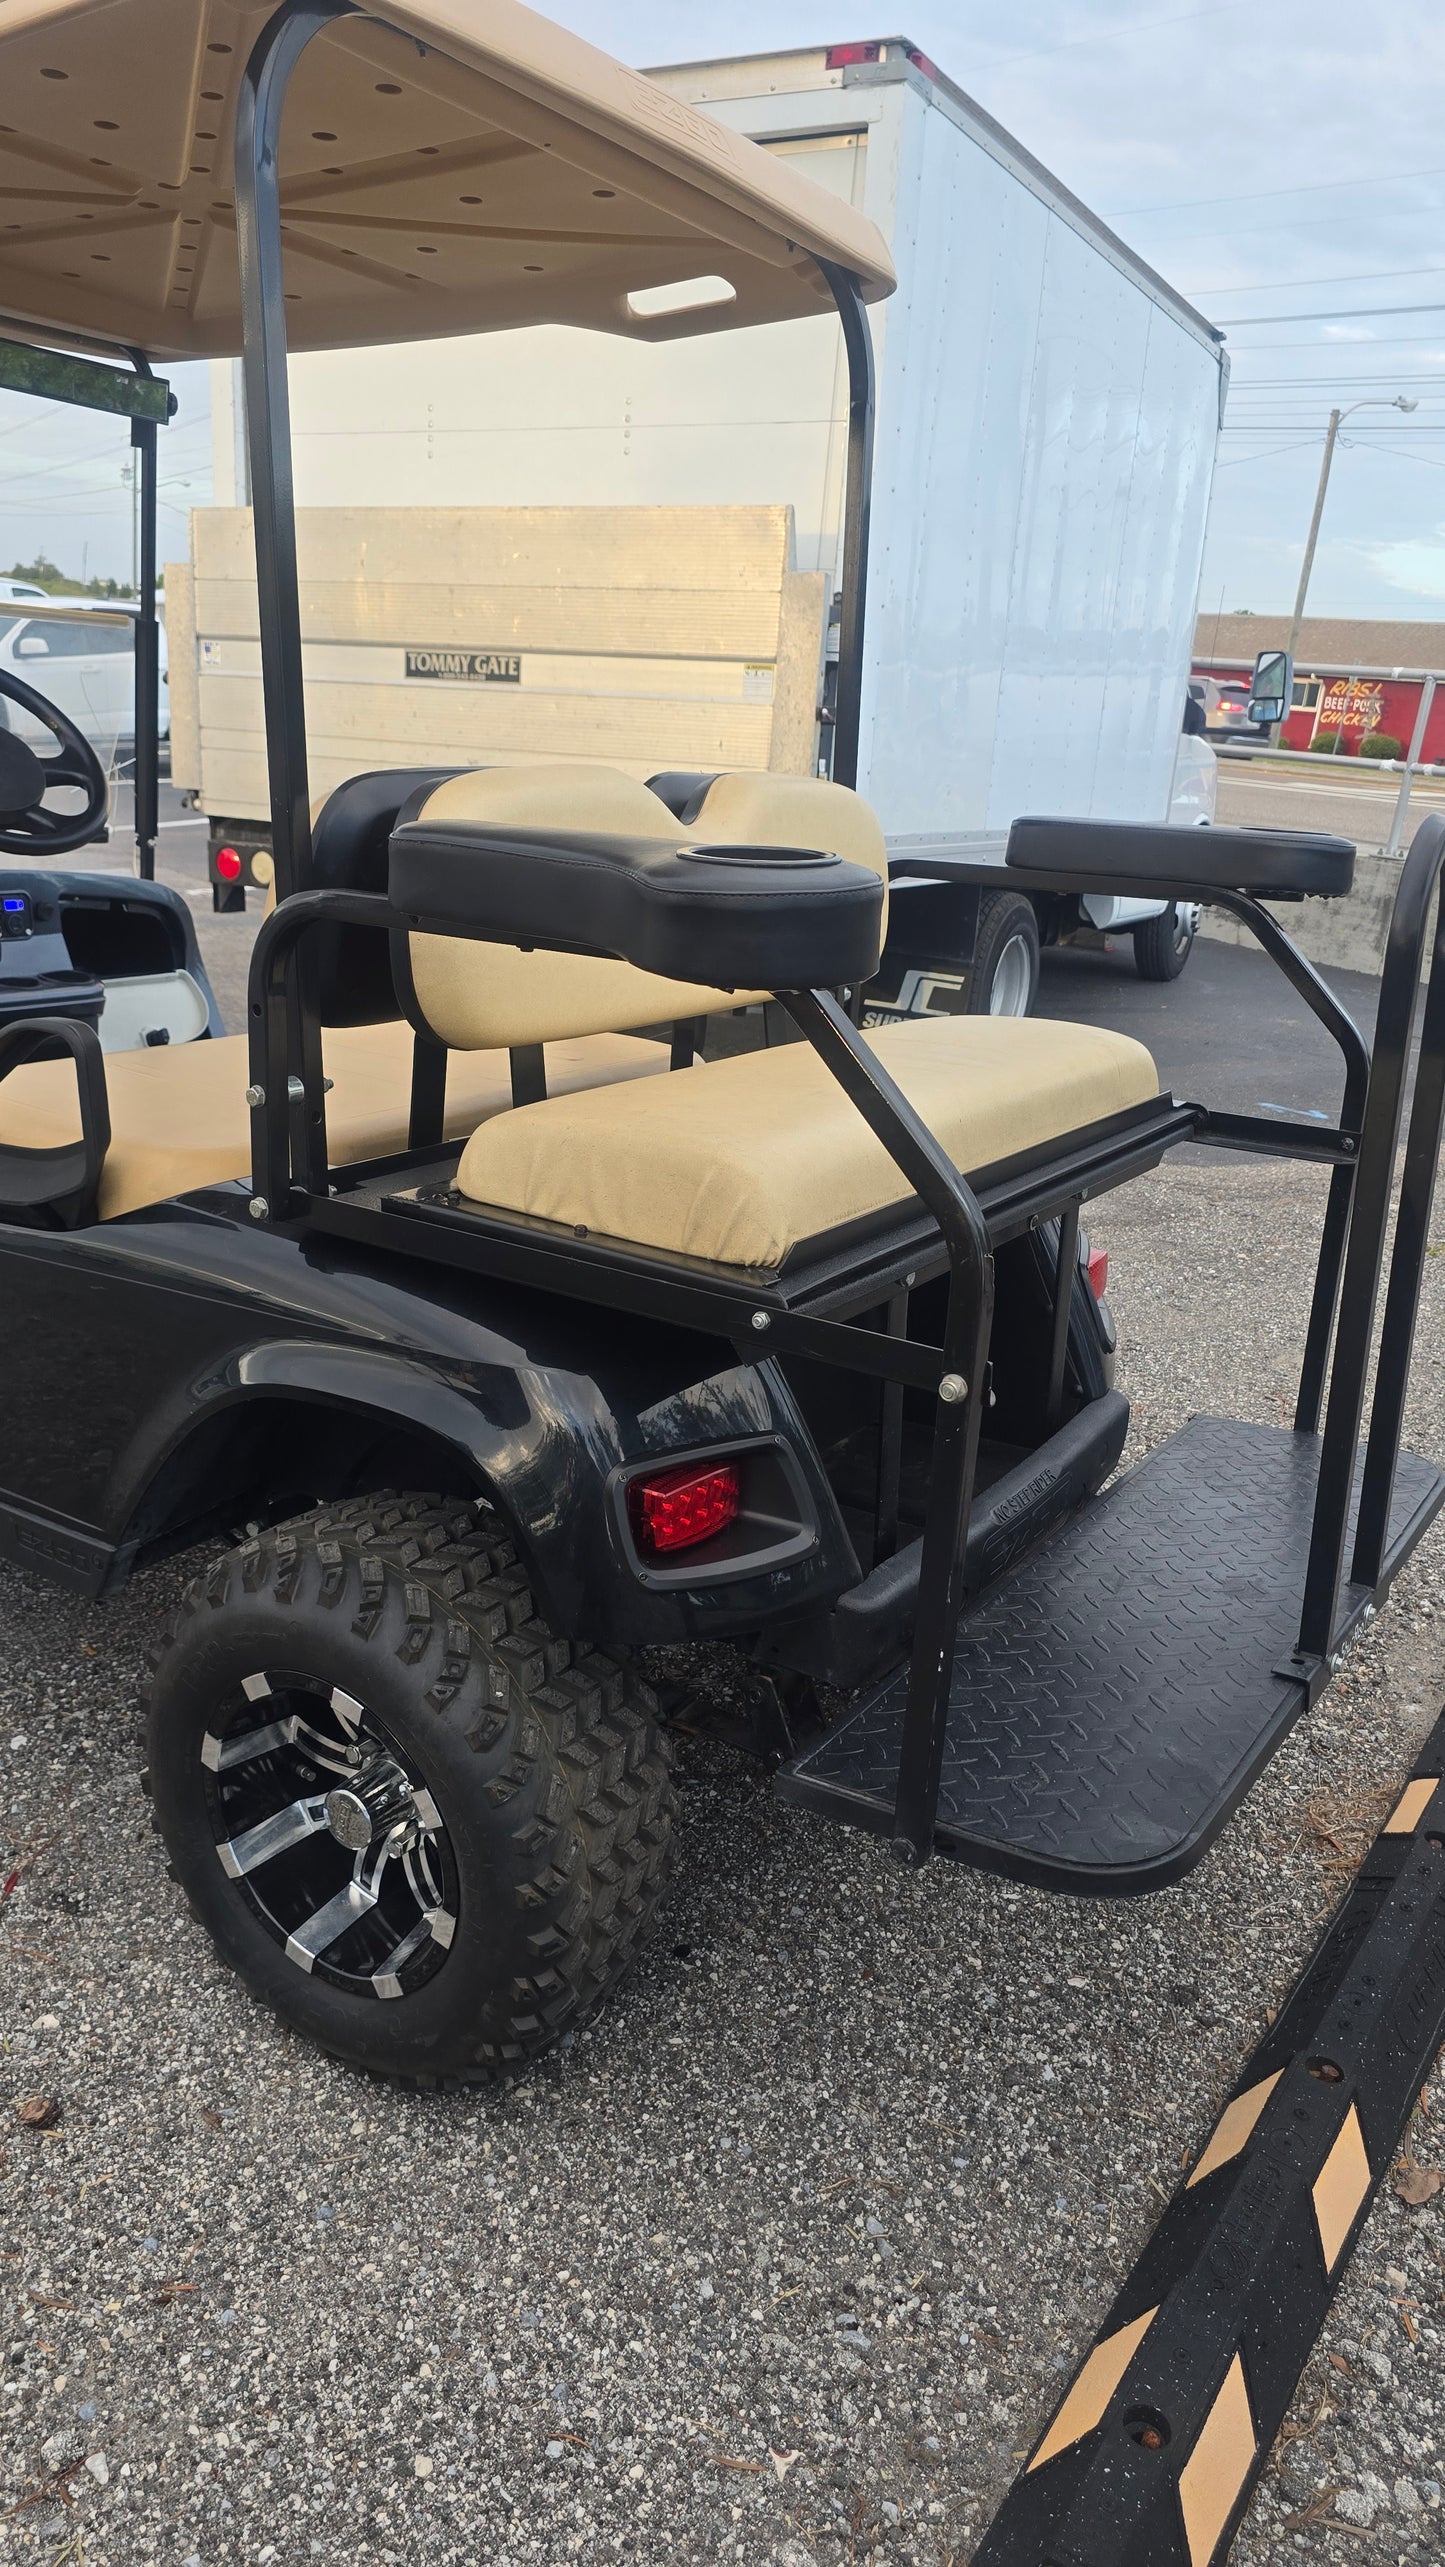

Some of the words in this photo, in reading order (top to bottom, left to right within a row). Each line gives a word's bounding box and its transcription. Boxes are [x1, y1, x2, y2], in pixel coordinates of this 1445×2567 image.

[407, 652, 471, 673] TOMMY
[474, 655, 519, 676] GATE
[993, 1503, 1011, 1524] NO
[1007, 1487, 1031, 1513] STEP
[1029, 1467, 1057, 1497] RIDER
